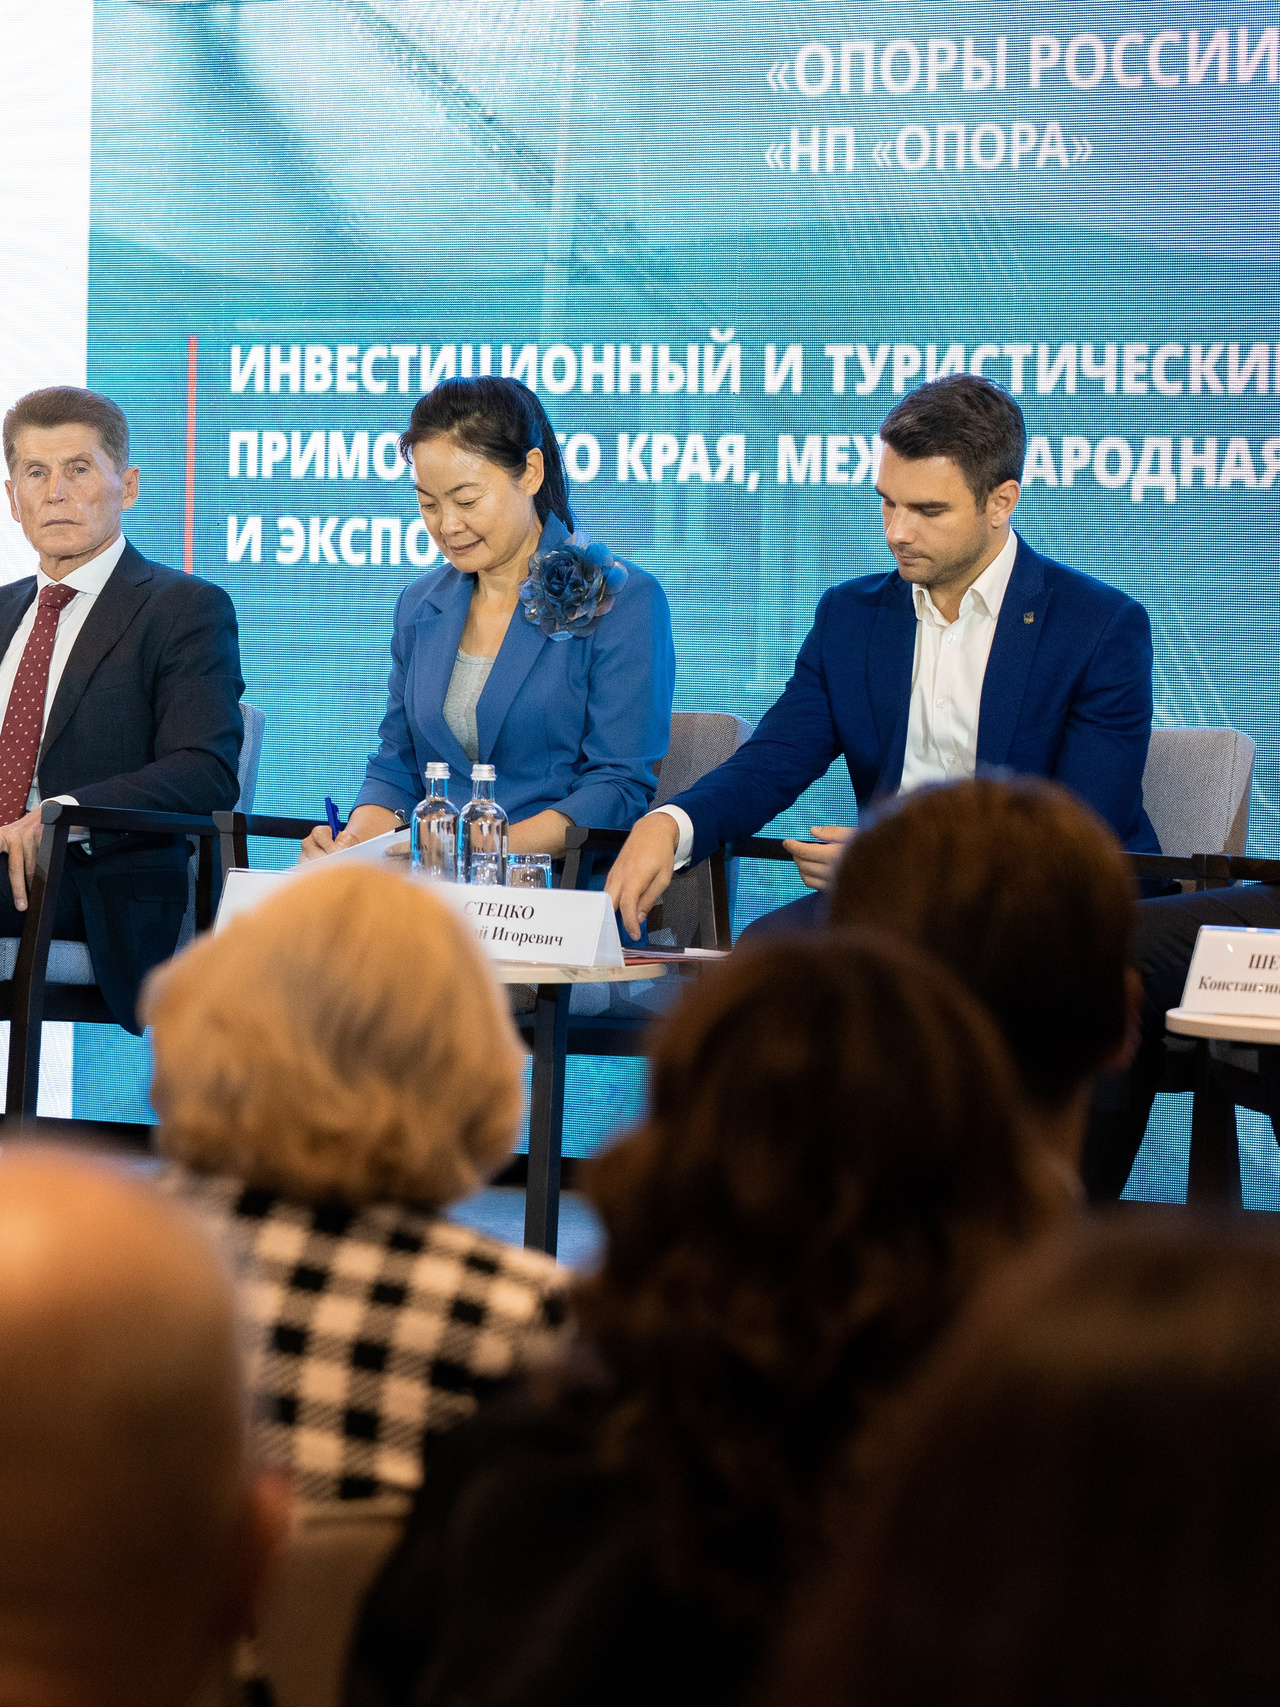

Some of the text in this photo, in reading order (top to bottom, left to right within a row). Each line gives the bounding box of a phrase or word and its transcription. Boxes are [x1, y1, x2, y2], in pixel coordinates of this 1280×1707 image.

[767, 26, 1280, 96] «ОПОРЫ РОССИИ
[765, 121, 1092, 173] «НП «ОПОРА»
[763, 343, 804, 395] И
[824, 342, 1280, 396] ТУРИСТИЧЕСКИ
[616, 432, 760, 493] КРАЯ,
[227, 514, 448, 567] И ЭКСПО
[491, 926, 564, 947] Игоревич
[1248, 953, 1280, 971] ШЕ
